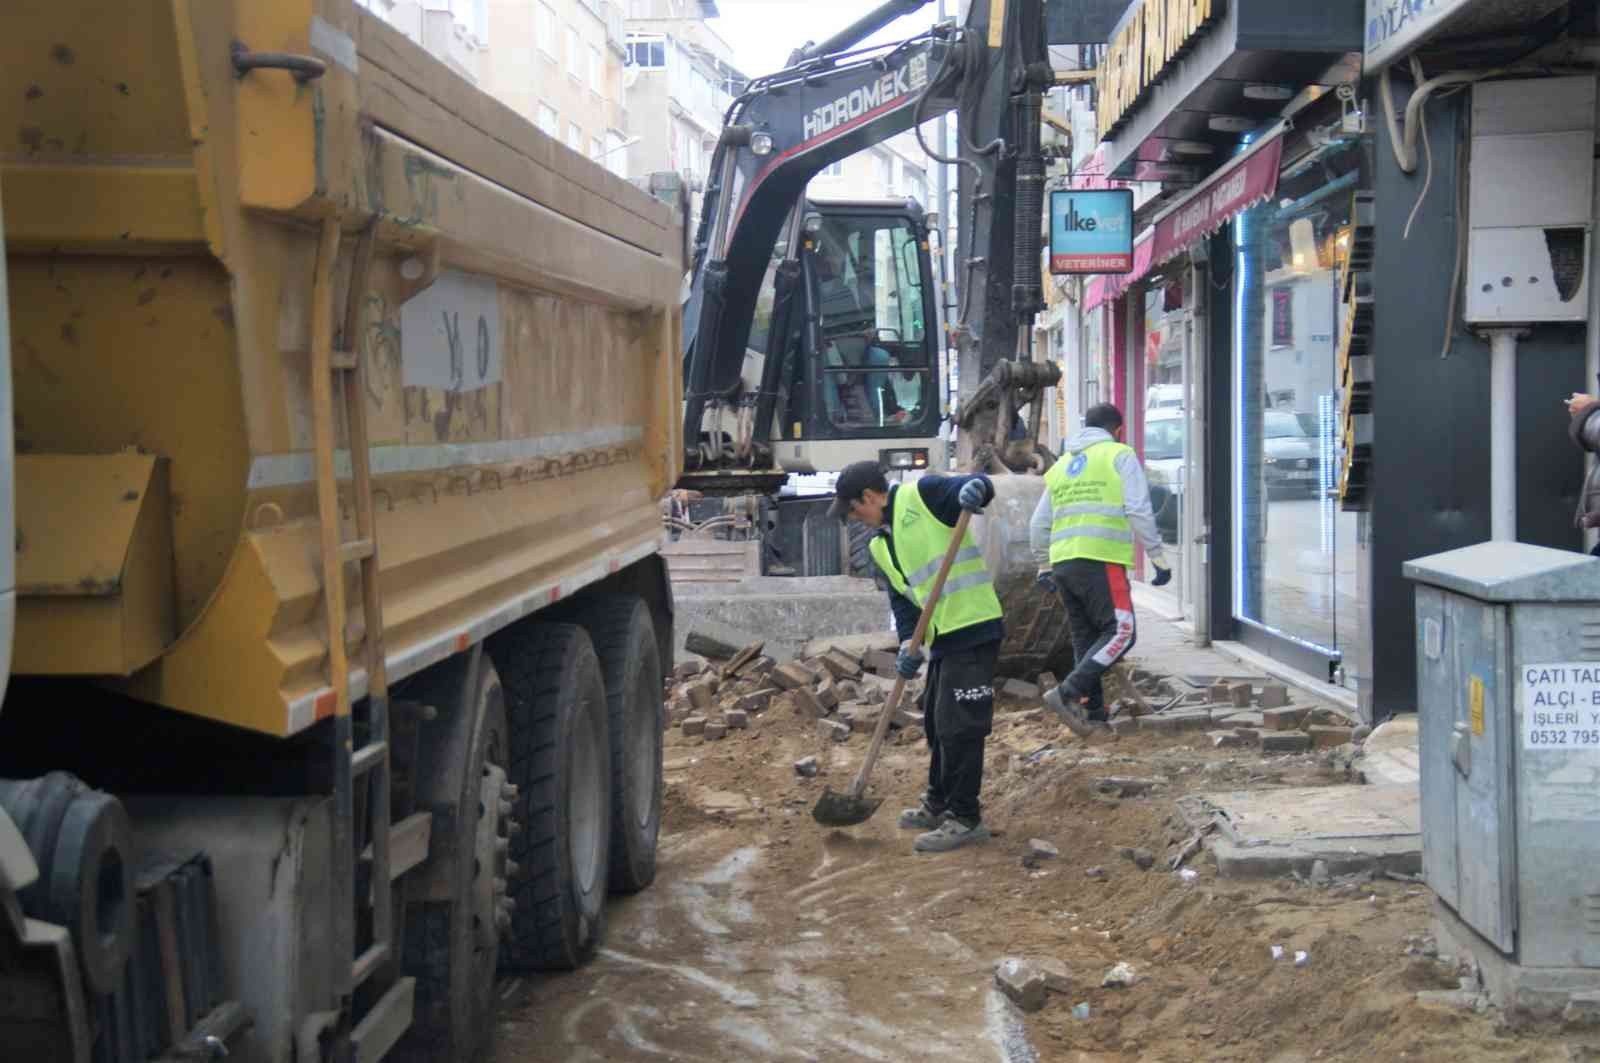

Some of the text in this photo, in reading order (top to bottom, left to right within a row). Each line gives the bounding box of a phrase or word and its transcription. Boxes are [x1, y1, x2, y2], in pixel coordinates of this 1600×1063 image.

[1526, 669, 1565, 687] ÇATI
[1534, 691, 1575, 709] ALÇI
[1533, 709, 1600, 727] İŞLERİ Y
[1530, 730, 1600, 744] 0532 795
